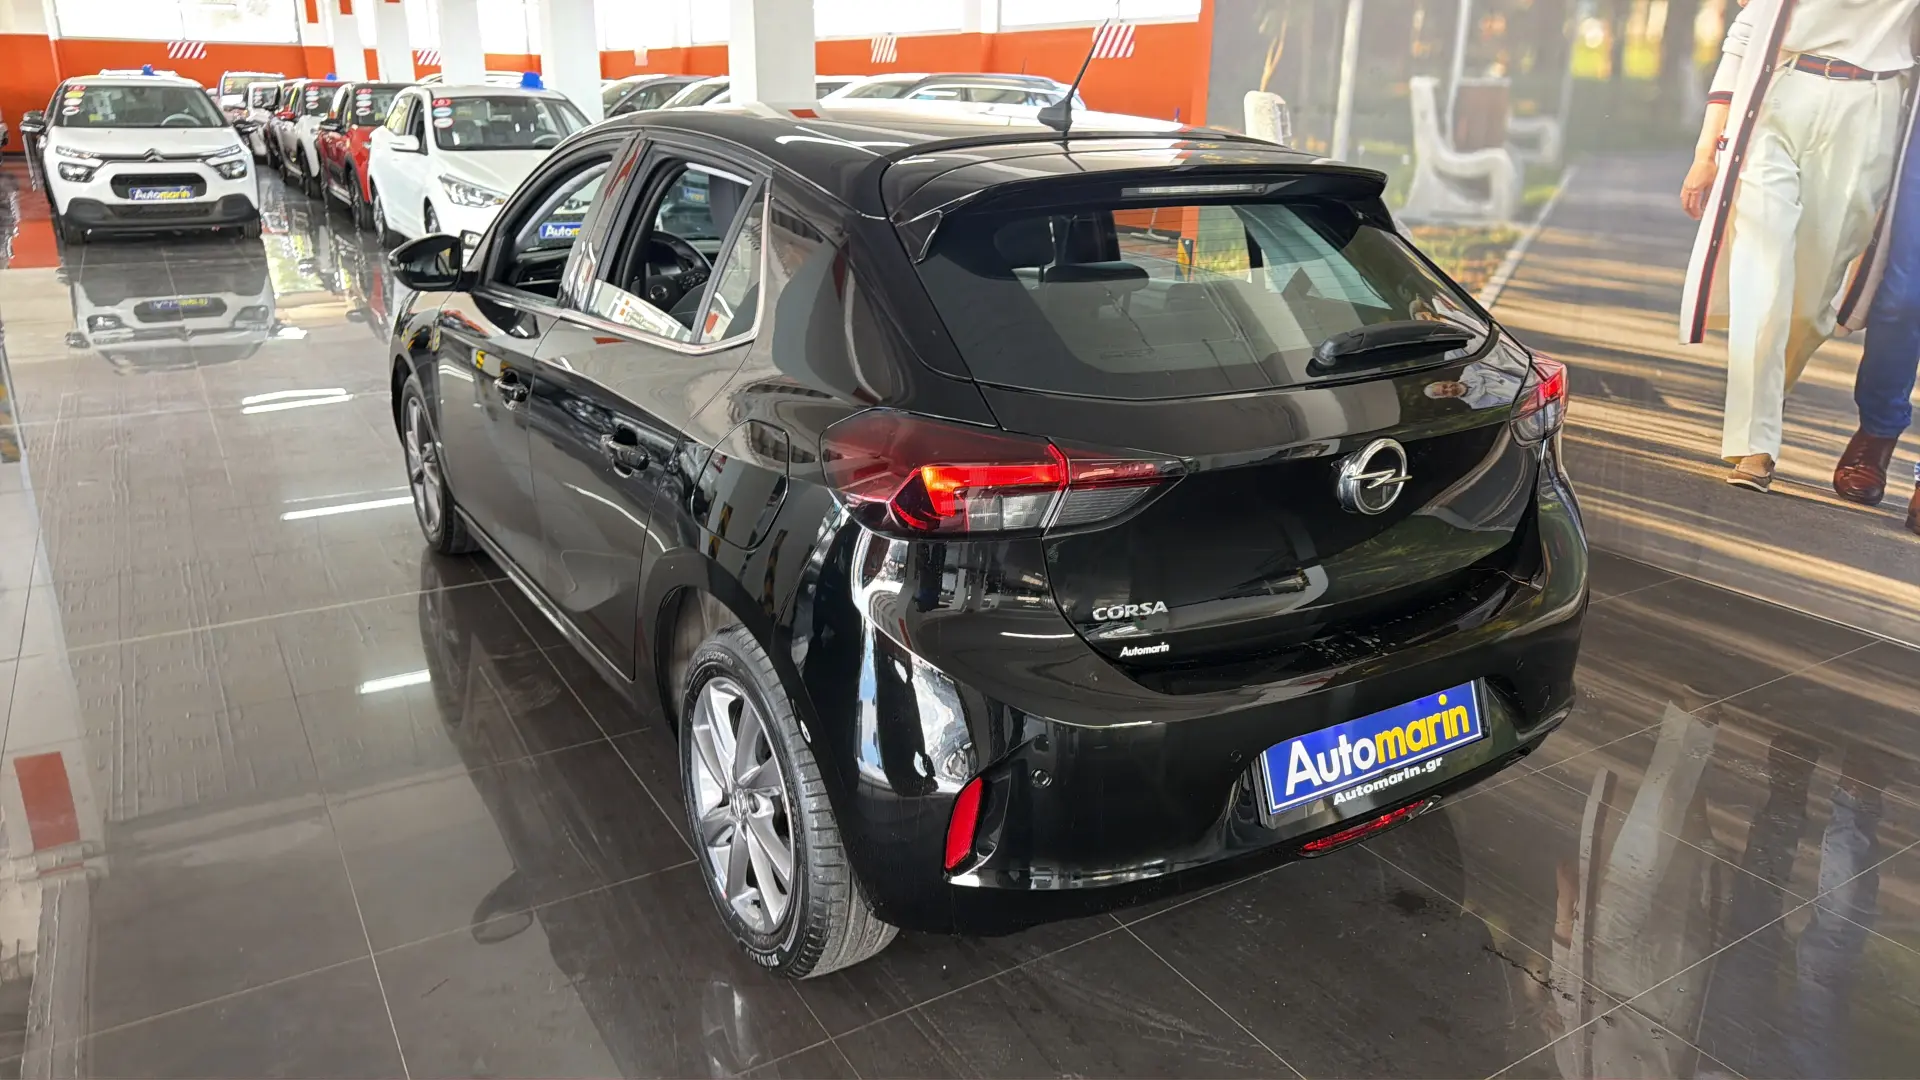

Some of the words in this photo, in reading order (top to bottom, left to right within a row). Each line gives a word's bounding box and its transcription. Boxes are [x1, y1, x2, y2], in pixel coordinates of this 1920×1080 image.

[1092, 600, 1169, 621] CORSA
[1119, 642, 1170, 658] Automarin
[1285, 694, 1470, 796] Automarin
[1333, 757, 1443, 805] Automarin.gr
